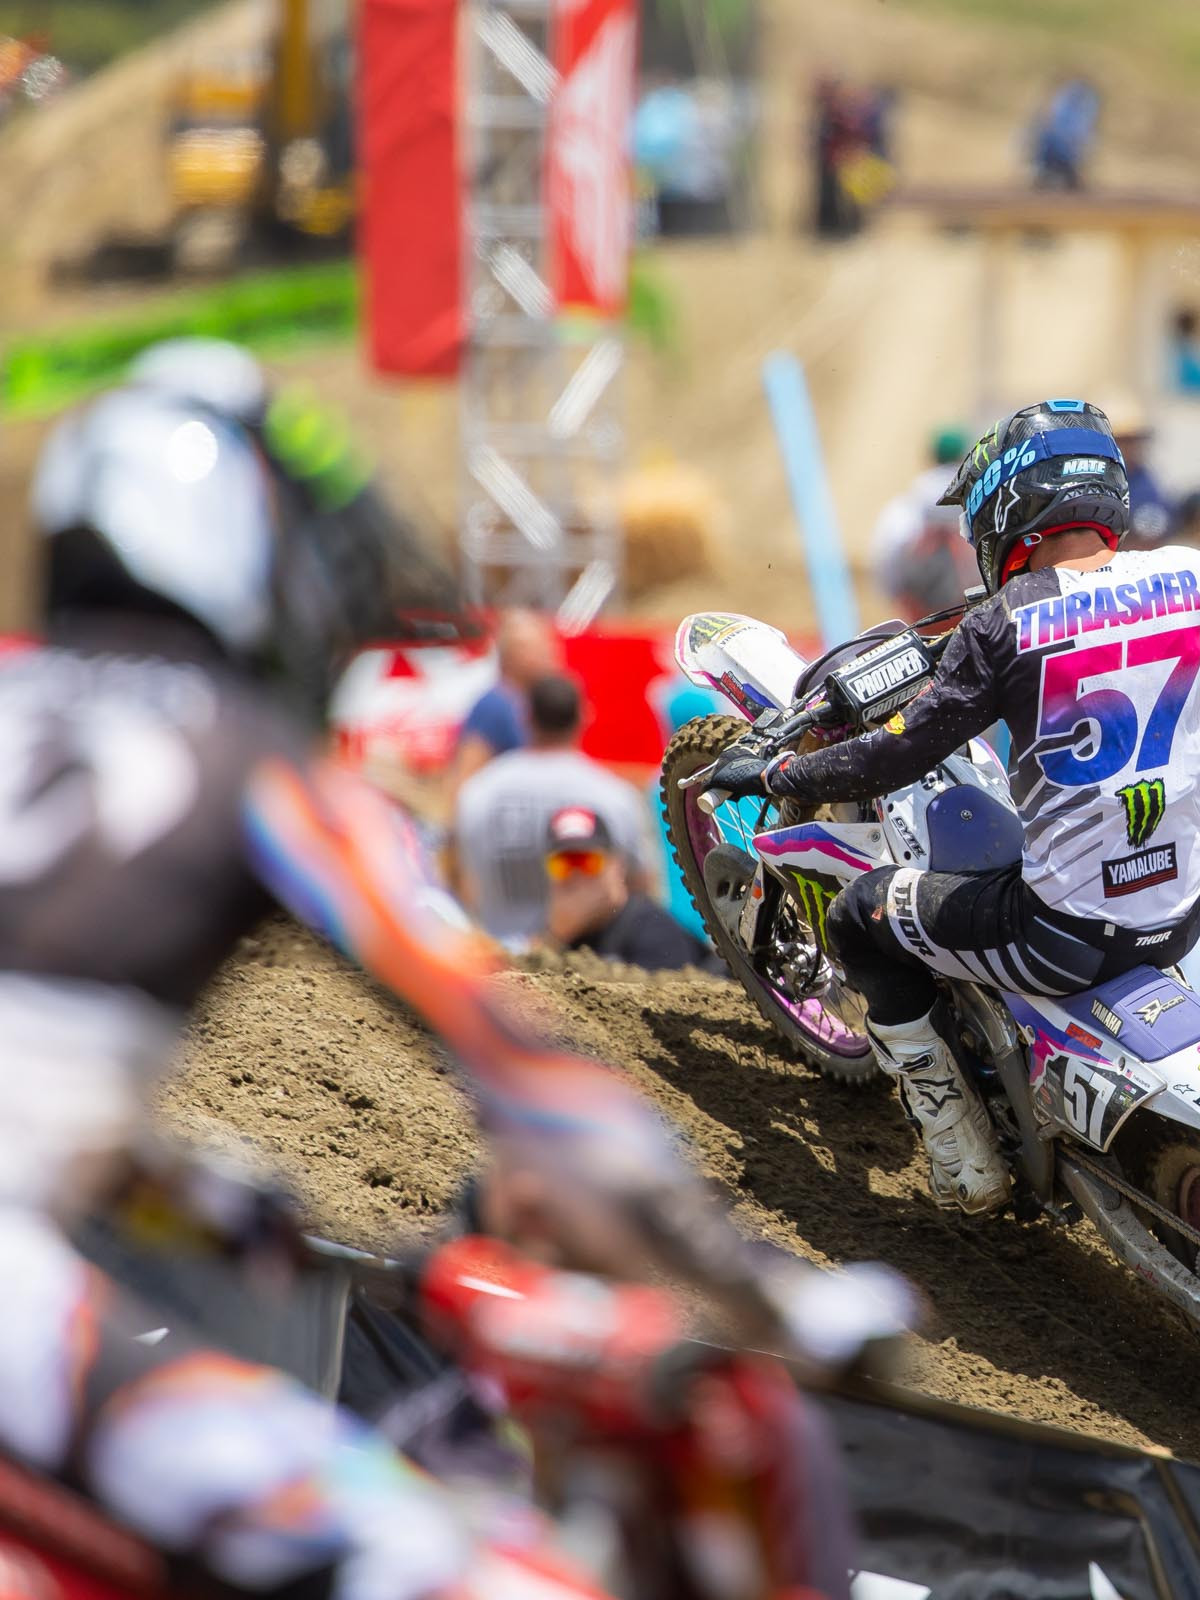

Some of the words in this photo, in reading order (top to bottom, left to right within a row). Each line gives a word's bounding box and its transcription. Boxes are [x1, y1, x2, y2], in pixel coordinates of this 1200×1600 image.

[1062, 459, 1106, 476] NATE
[854, 651, 924, 700] PROTAPER
[1108, 853, 1174, 884] YAMALUBE
[1135, 931, 1172, 946] THOR
[1091, 1000, 1122, 1036] YAMAHA
[1064, 1056, 1117, 1147] 57
